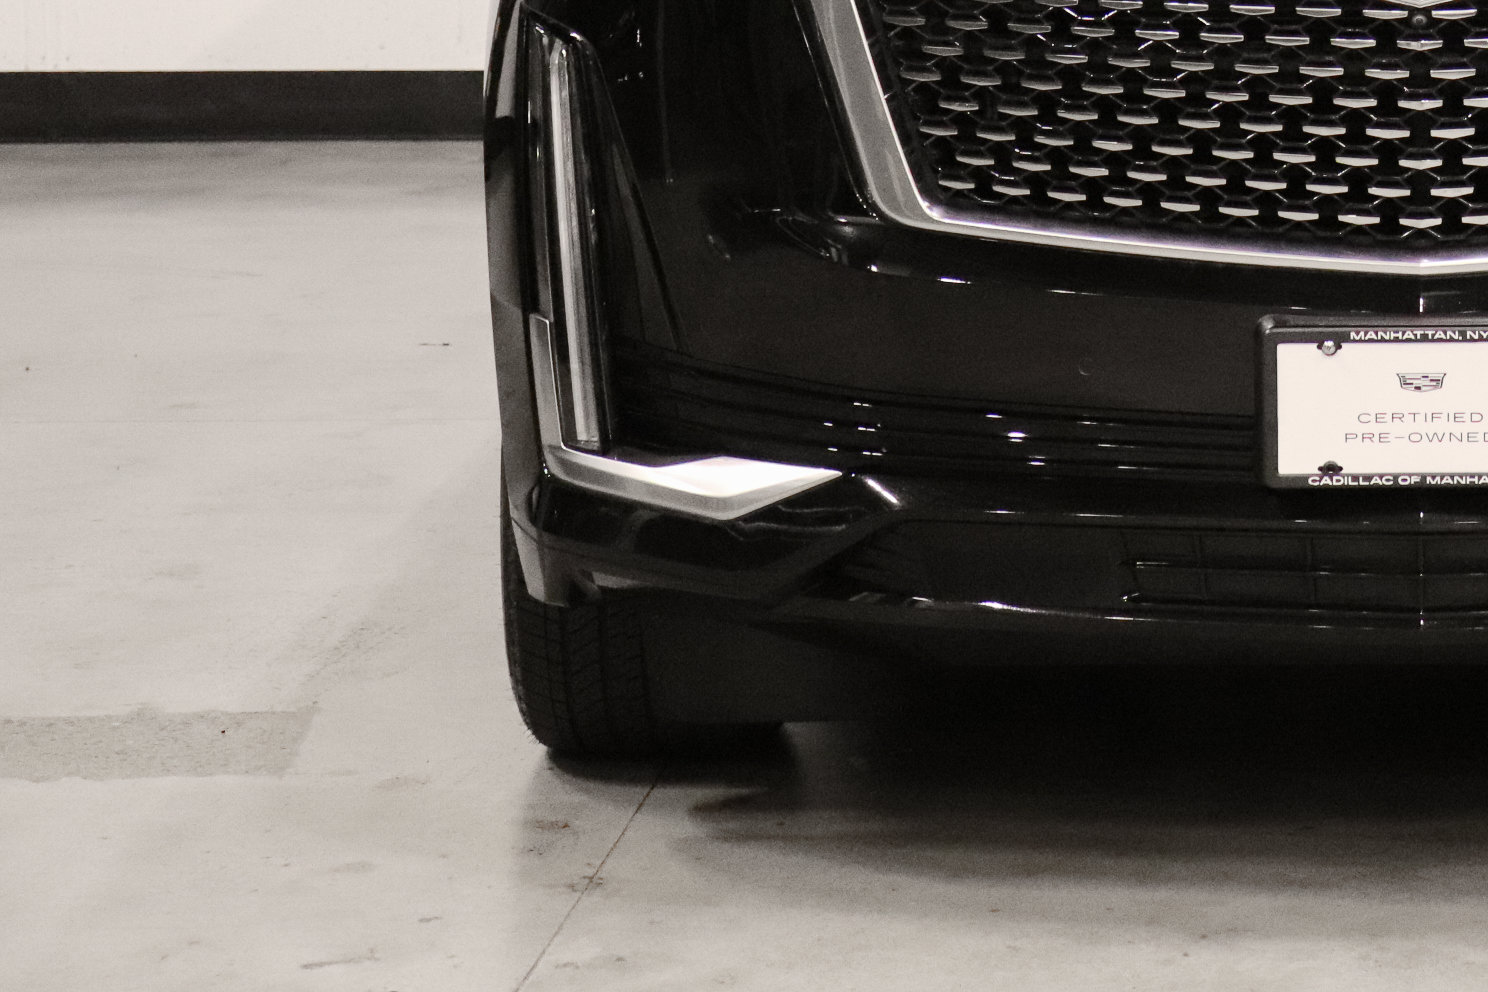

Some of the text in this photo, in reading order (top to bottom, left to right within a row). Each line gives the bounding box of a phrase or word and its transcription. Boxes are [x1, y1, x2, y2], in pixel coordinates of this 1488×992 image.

[1357, 412, 1484, 424] CERTIFIED
[1307, 475, 1394, 486] CADILLAC
[1397, 475, 1422, 486] OF
